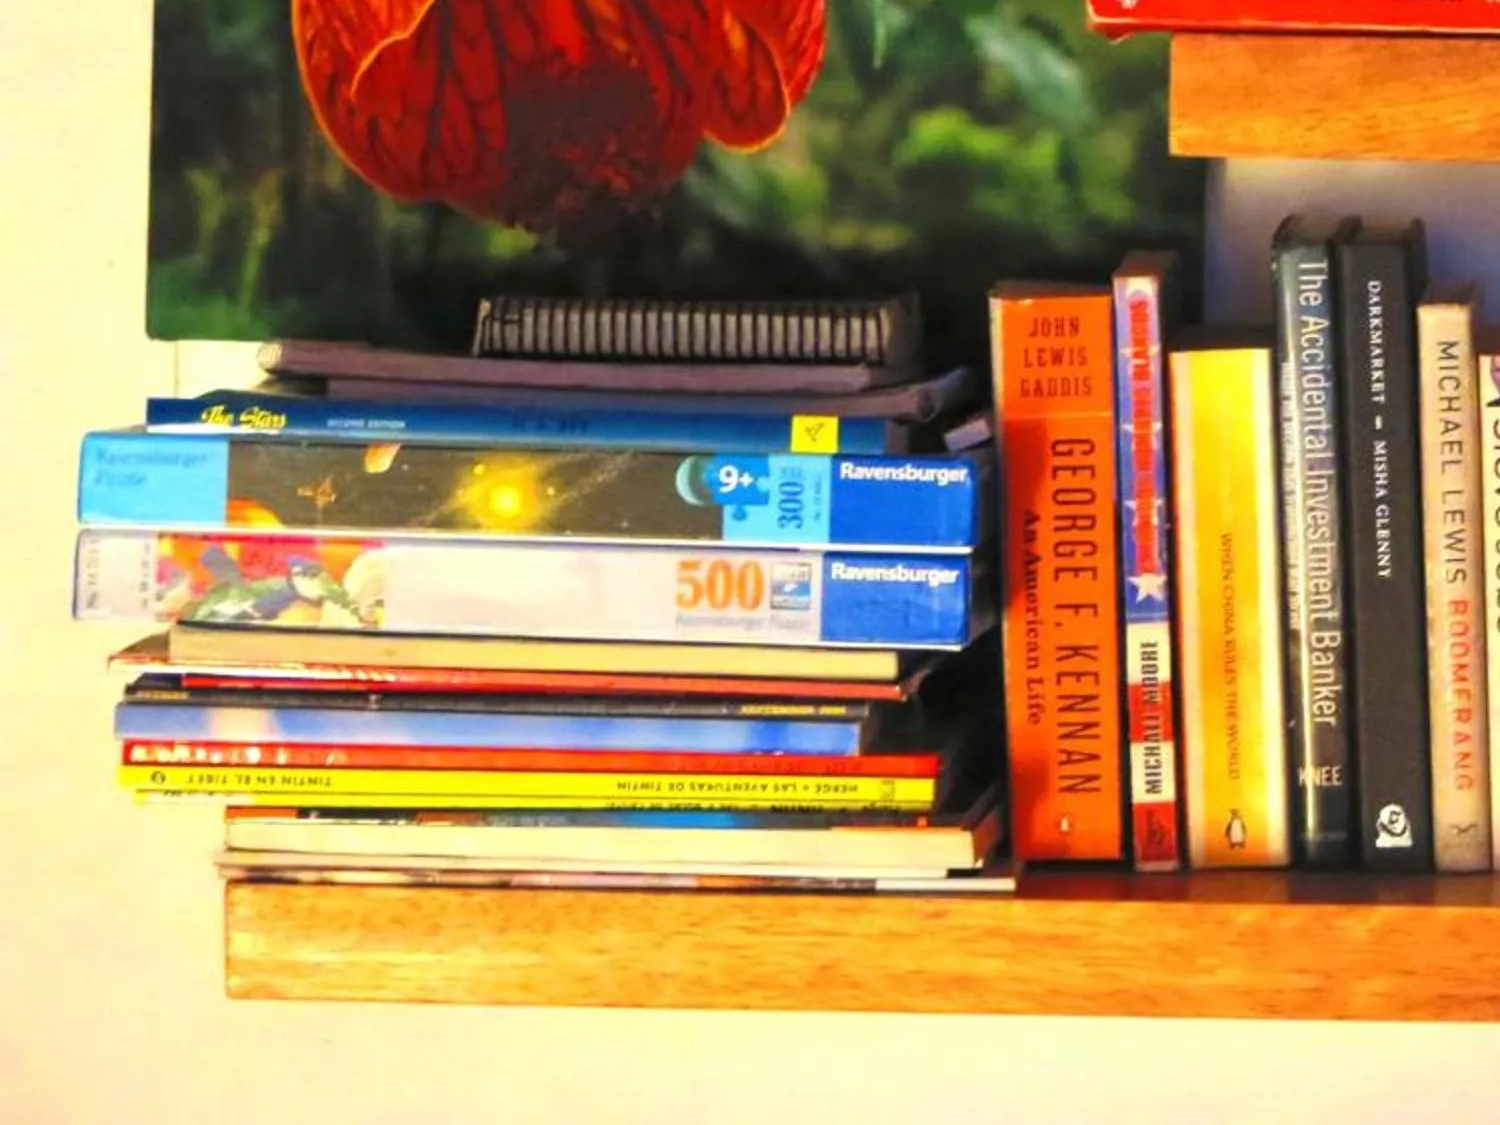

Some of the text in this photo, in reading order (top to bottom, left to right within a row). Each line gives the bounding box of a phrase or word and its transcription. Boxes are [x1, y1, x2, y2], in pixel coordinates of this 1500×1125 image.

[1028, 316, 1081, 339] JOHN
[1023, 346, 1088, 369] LEWIS
[1019, 377, 1094, 399] GADDIS
[203, 402, 233, 426] The
[1366, 279, 1393, 578] DARKMARKET MISHA GLENNY
[718, 463, 753, 493] 9+
[840, 460, 970, 485] Ravensburger
[777, 479, 806, 530] 300
[1297, 259, 1342, 727] The Accidental Investment Banker
[674, 559, 765, 611] 500
[831, 561, 959, 586] Ravensburger
[1437, 340, 1476, 792] MICHAEL LEWIS BOOMERANG
[1024, 509, 1045, 725] An American Life
[1051, 437, 1105, 795] GEORGE F. KENNAN
